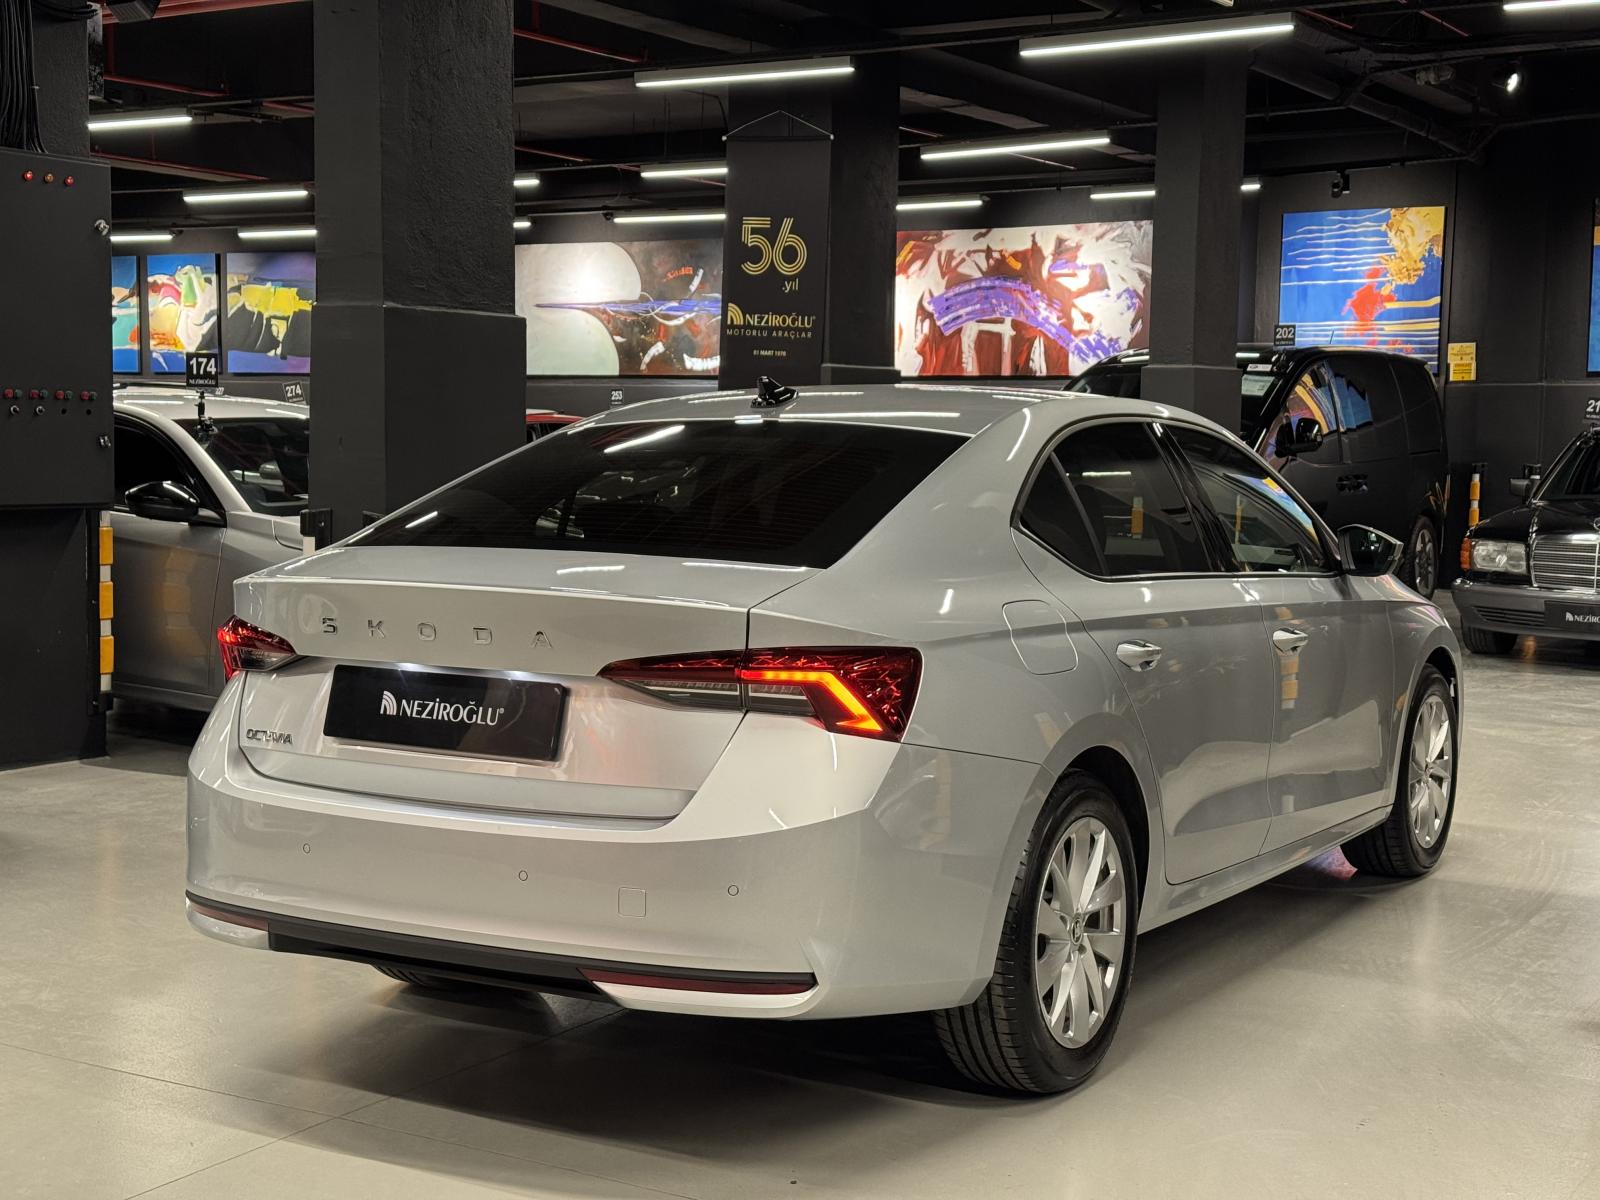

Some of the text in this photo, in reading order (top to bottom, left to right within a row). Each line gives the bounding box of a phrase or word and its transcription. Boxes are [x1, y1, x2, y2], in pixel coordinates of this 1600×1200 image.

[741, 216, 807, 275] 56
[745, 312, 813, 328] NEZİROĞLU
[726, 328, 812, 340] MOTORLU ARAÇLAR
[1275, 327, 1295, 339] 202
[189, 357, 217, 375] 174
[285, 384, 302, 397] 274
[400, 698, 501, 726] NEZİROĞLU
